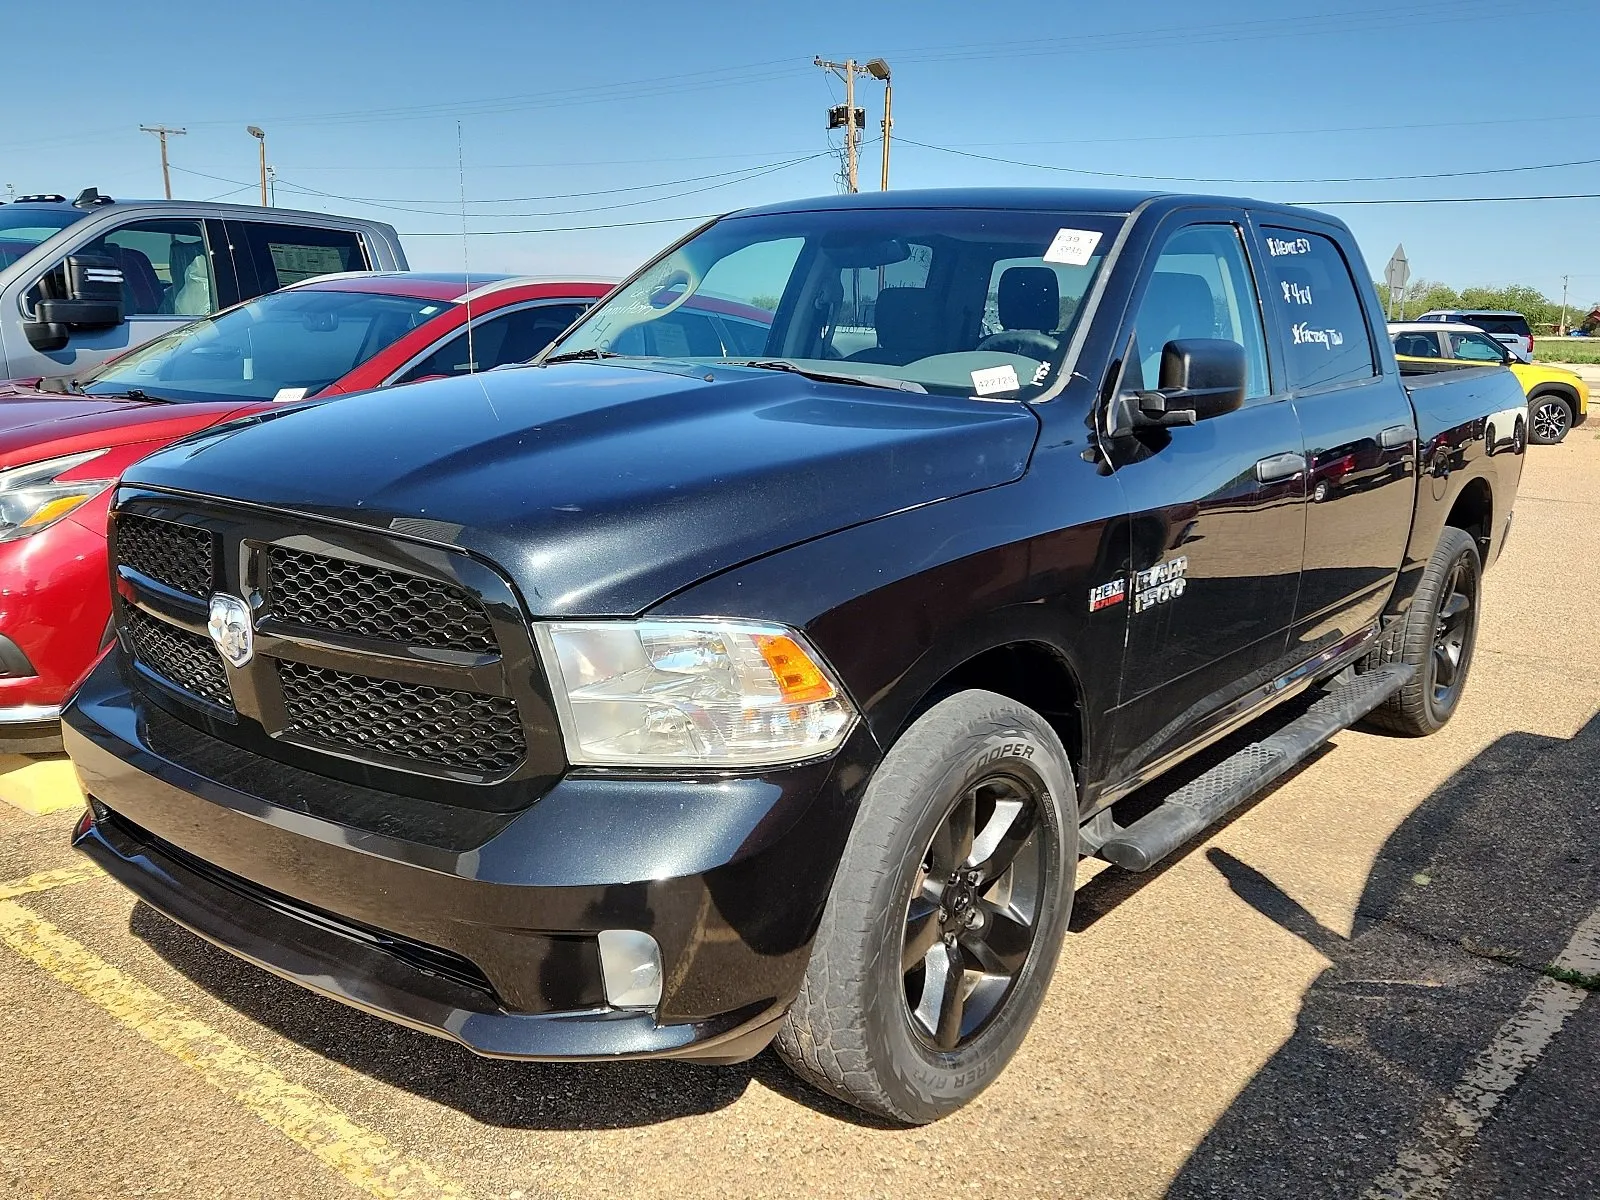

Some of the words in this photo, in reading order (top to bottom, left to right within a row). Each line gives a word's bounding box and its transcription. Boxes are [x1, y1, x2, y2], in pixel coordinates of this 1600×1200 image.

[1089, 578, 1125, 601] HEMI
[1135, 577, 1187, 614] 1500
[964, 743, 1035, 780] COOPER
